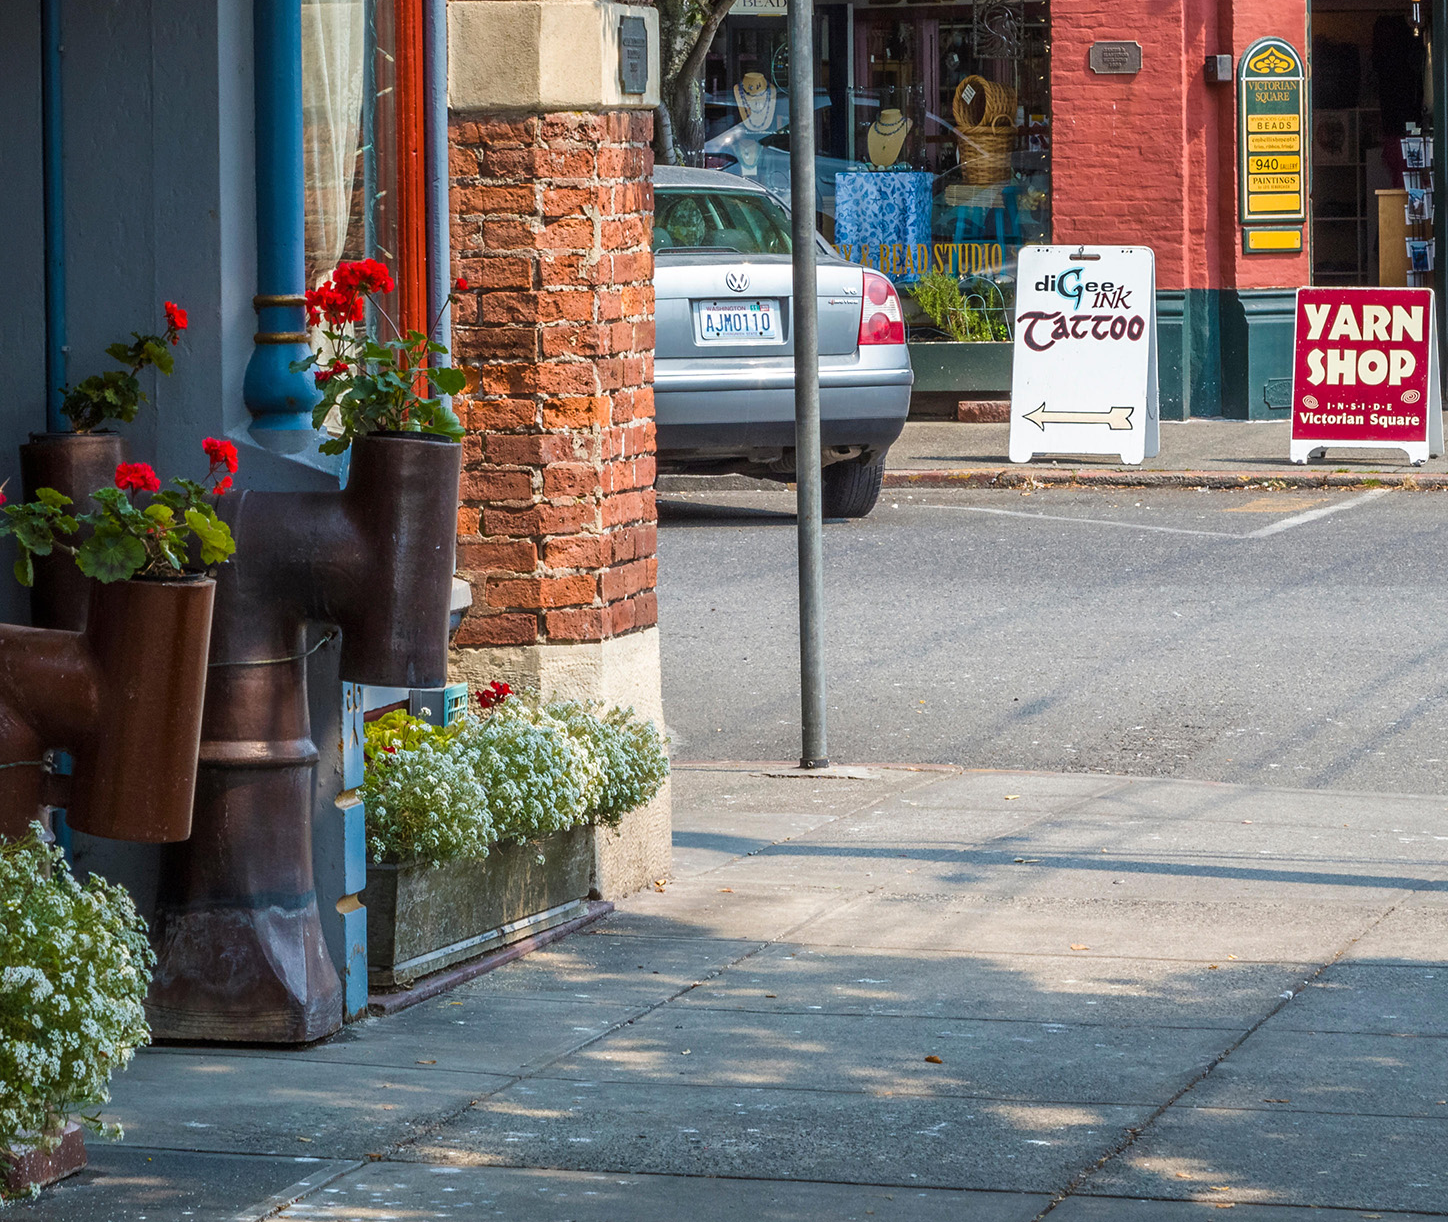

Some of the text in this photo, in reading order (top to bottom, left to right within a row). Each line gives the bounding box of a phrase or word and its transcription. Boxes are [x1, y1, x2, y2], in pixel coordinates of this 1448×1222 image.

[1248, 80, 1297, 91] VICTORIAN
[1255, 91, 1290, 104] SQUARE
[1257, 122, 1292, 130] BEADS
[1255, 158, 1279, 171] 940
[1253, 176, 1296, 185] PAINTINGS
[879, 243, 928, 275] BEAD
[933, 242, 1003, 275] STUDIO
[1303, 304, 1425, 342] YARN
[1306, 348, 1417, 386] SHOP
[1299, 412, 1420, 428] Victorian Square
